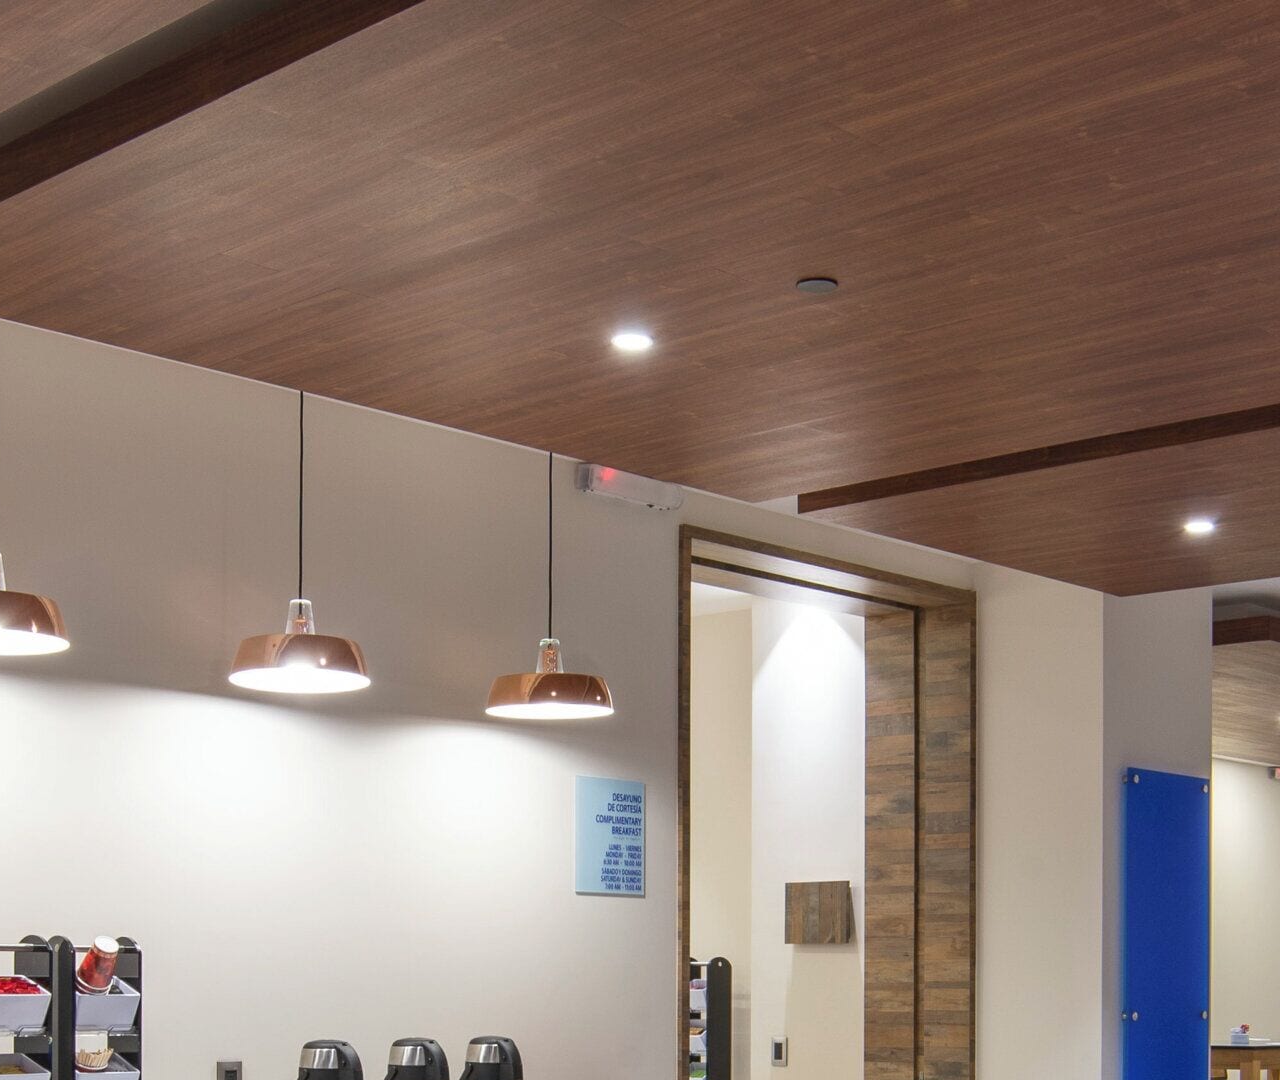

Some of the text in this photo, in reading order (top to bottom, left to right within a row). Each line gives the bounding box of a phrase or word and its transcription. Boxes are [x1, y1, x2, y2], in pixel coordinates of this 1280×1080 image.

[612, 793, 642, 803] DESAYUNO
[608, 803, 615, 812] DE
[595, 814, 642, 826] COMPLIMENTARY
[612, 826, 642, 836] BREAKFAST
